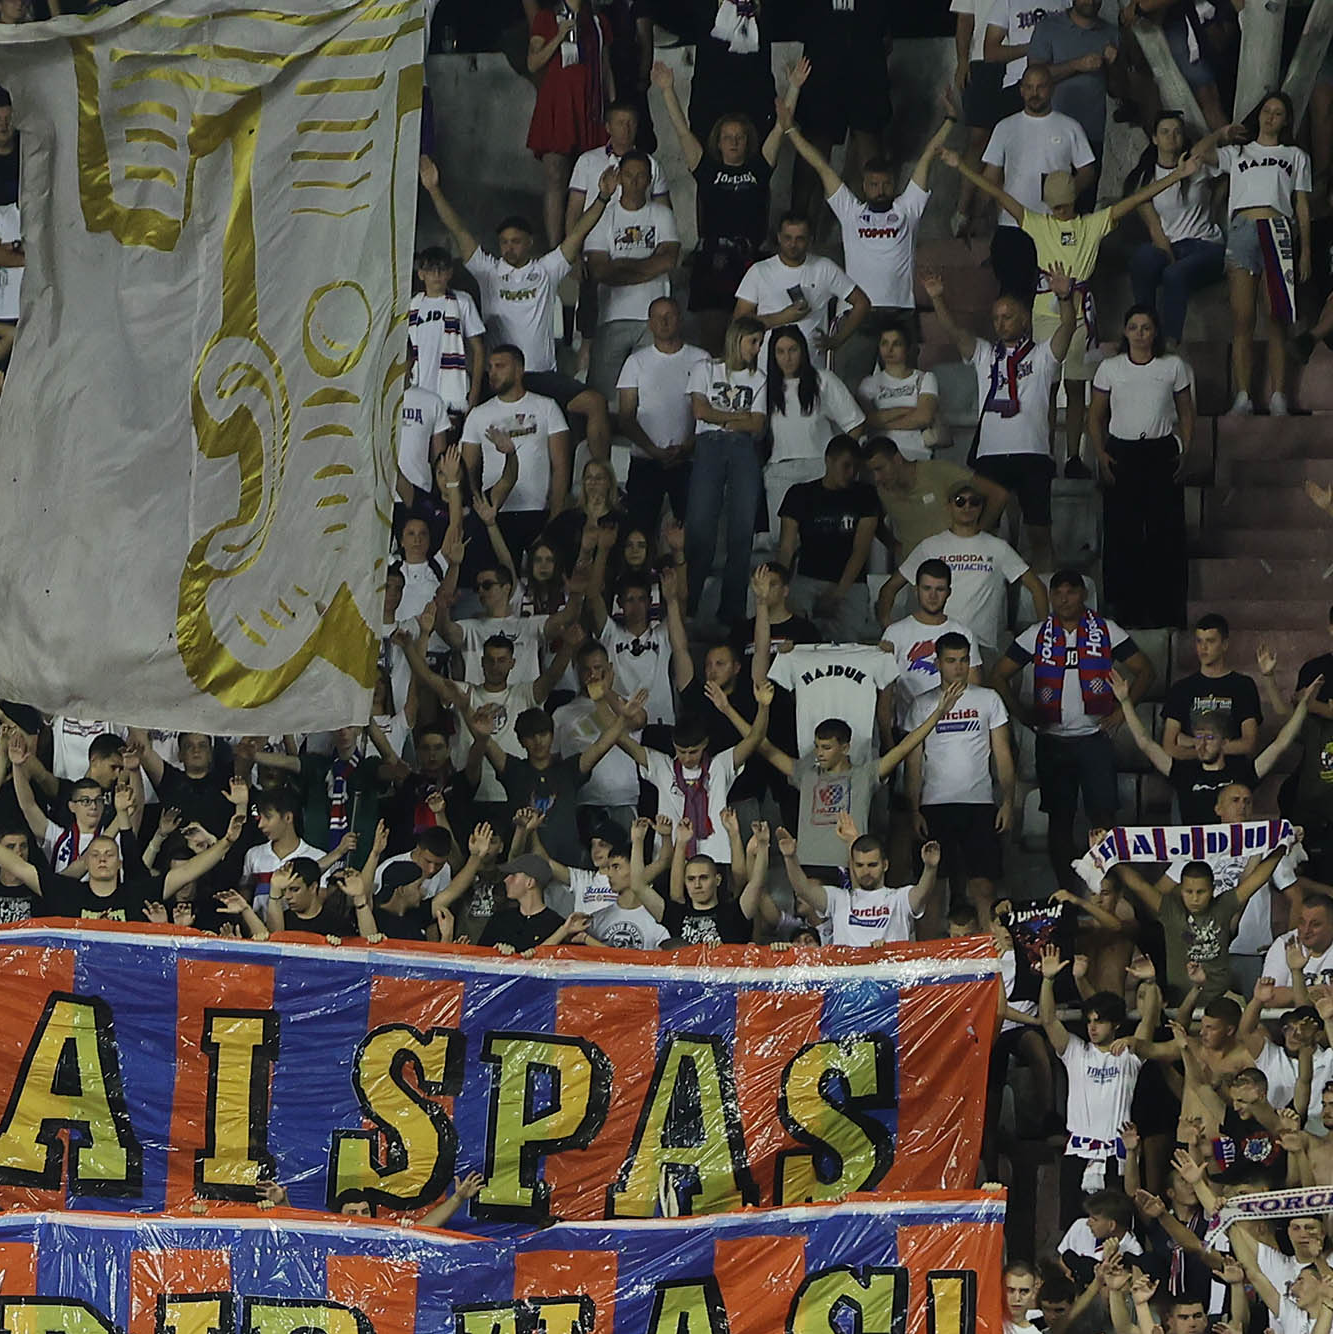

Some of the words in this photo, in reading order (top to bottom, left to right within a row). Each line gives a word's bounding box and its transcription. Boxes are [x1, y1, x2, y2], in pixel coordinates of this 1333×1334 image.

[858, 227, 901, 240] TOMMY
[801, 663, 868, 686] HAJDUK
[851, 904, 891, 920] orcida
[194, 1008, 281, 1200] I
[326, 1023, 897, 1221] SPAS
